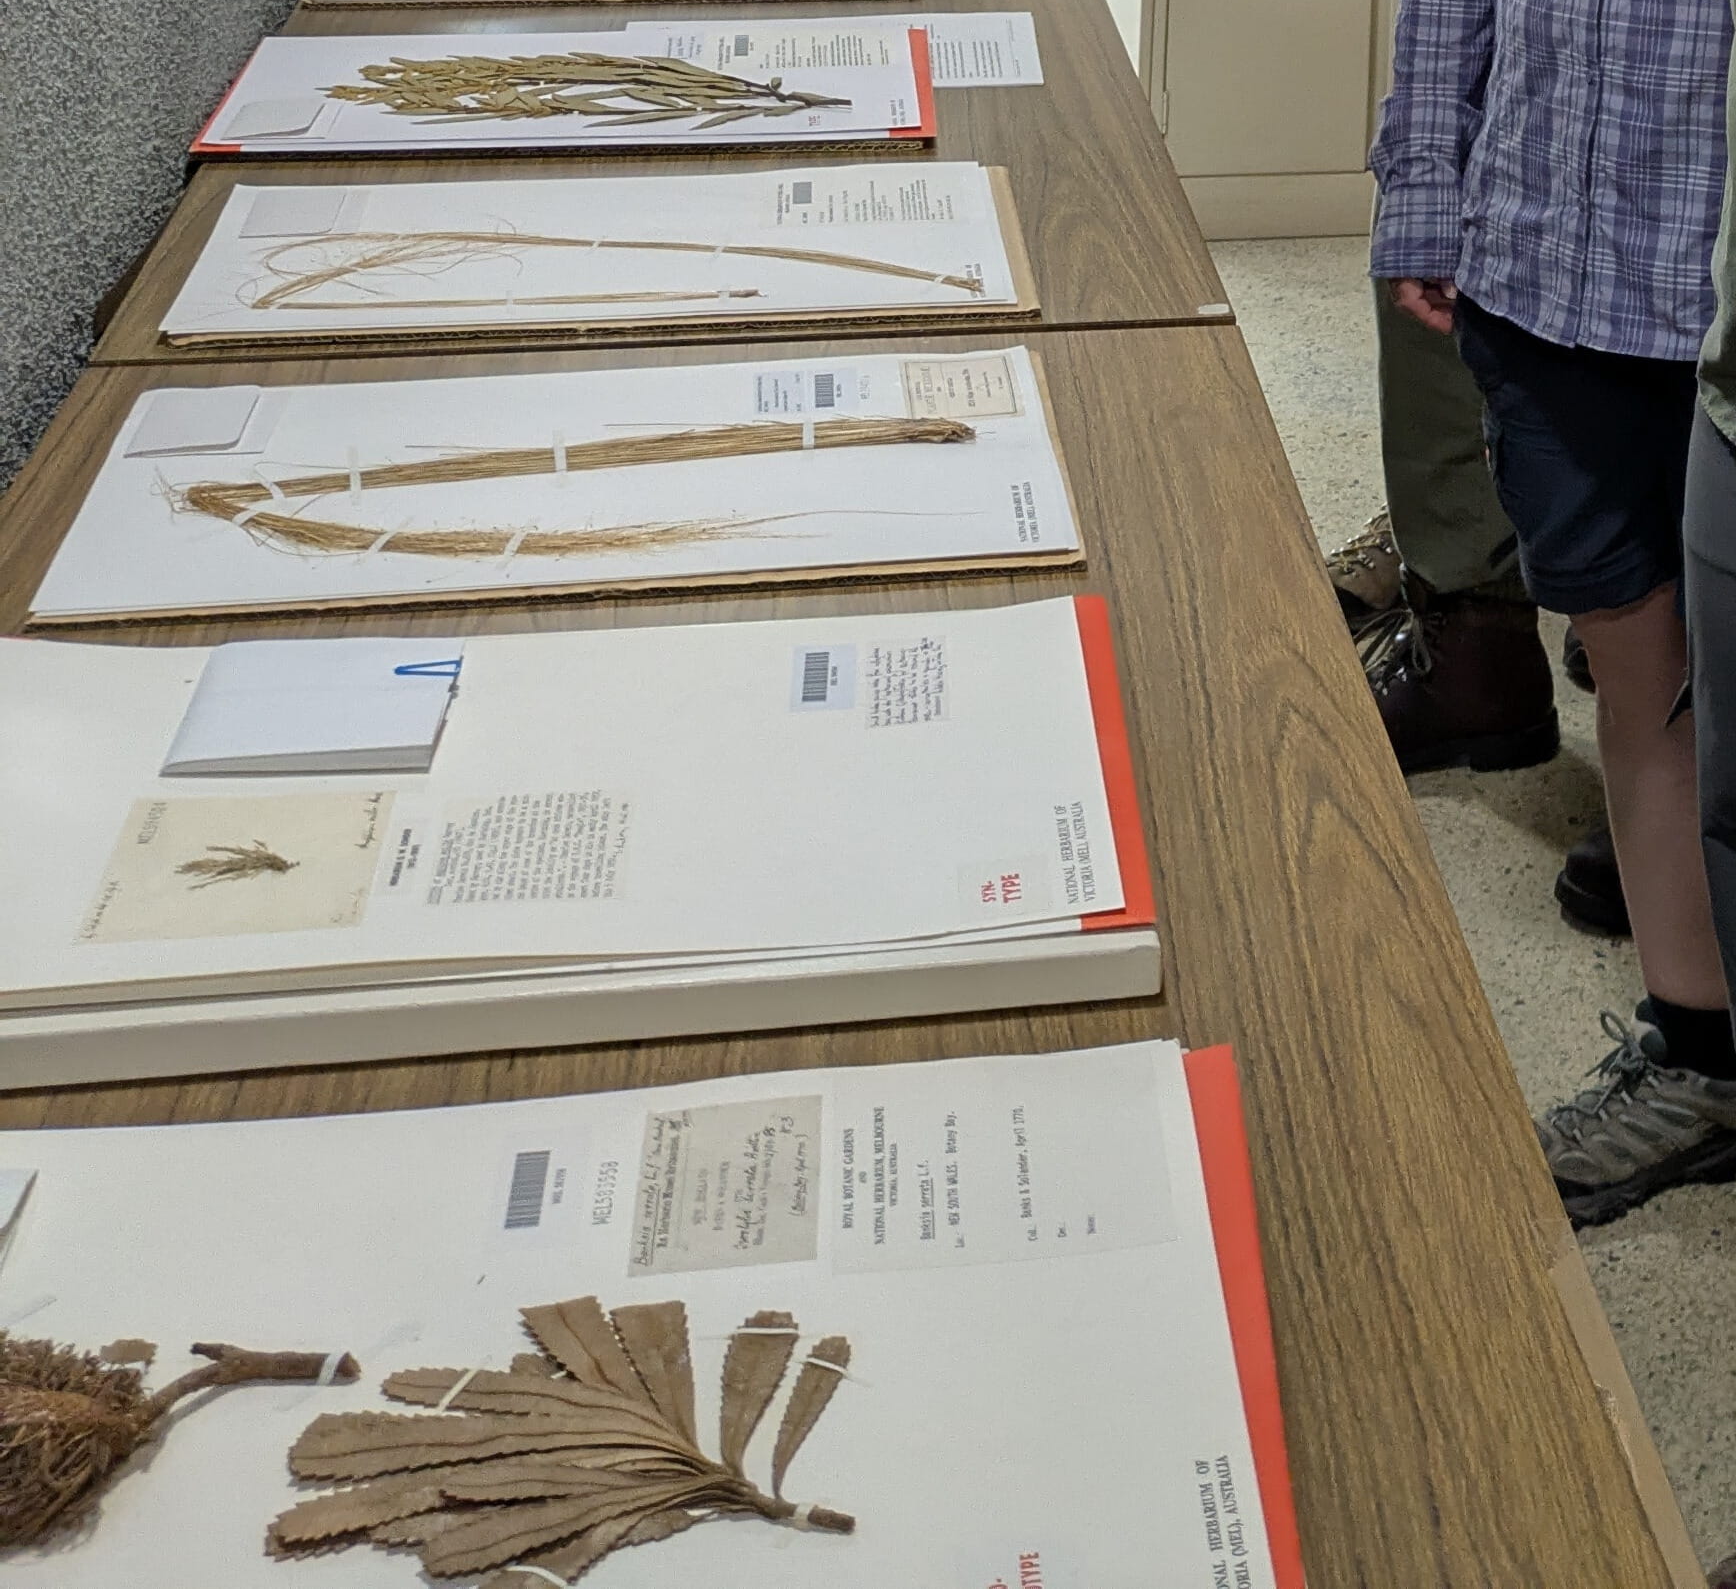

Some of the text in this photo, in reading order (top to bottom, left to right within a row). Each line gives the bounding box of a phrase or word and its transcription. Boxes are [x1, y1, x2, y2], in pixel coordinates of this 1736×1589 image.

[1070, 800, 1088, 840] AUSTRALIA
[1053, 804, 1080, 905] NATIONAL HERBARIUM OF
[981, 880, 997, 903] SYN-
[1000, 873, 1022, 904] TYPE
[1080, 865, 1097, 902] VICTORIA
[873, 1106, 885, 1154] MELBOURNE
[945, 1131, 957, 1154] Botany
[1015, 1128, 1027, 1147] April
[842, 1128, 855, 1229] ROYAL BOTANIC GARDENS
[920, 1179, 931, 1209] serrata
[947, 1188, 960, 1211] SOUTH
[1020, 1196, 1033, 1218] Banks
[873, 1208, 886, 1245] NATIONAL
[919, 1212, 932, 1240] Banksia
[947, 1212, 960, 1226] NEW
[1195, 1459, 1210, 1475] OF
[1215, 1454, 1238, 1515] AUSTRALIA
[1198, 1482, 1224, 1552] HERBARIUM
[1226, 1517, 1249, 1558] (MEL),
